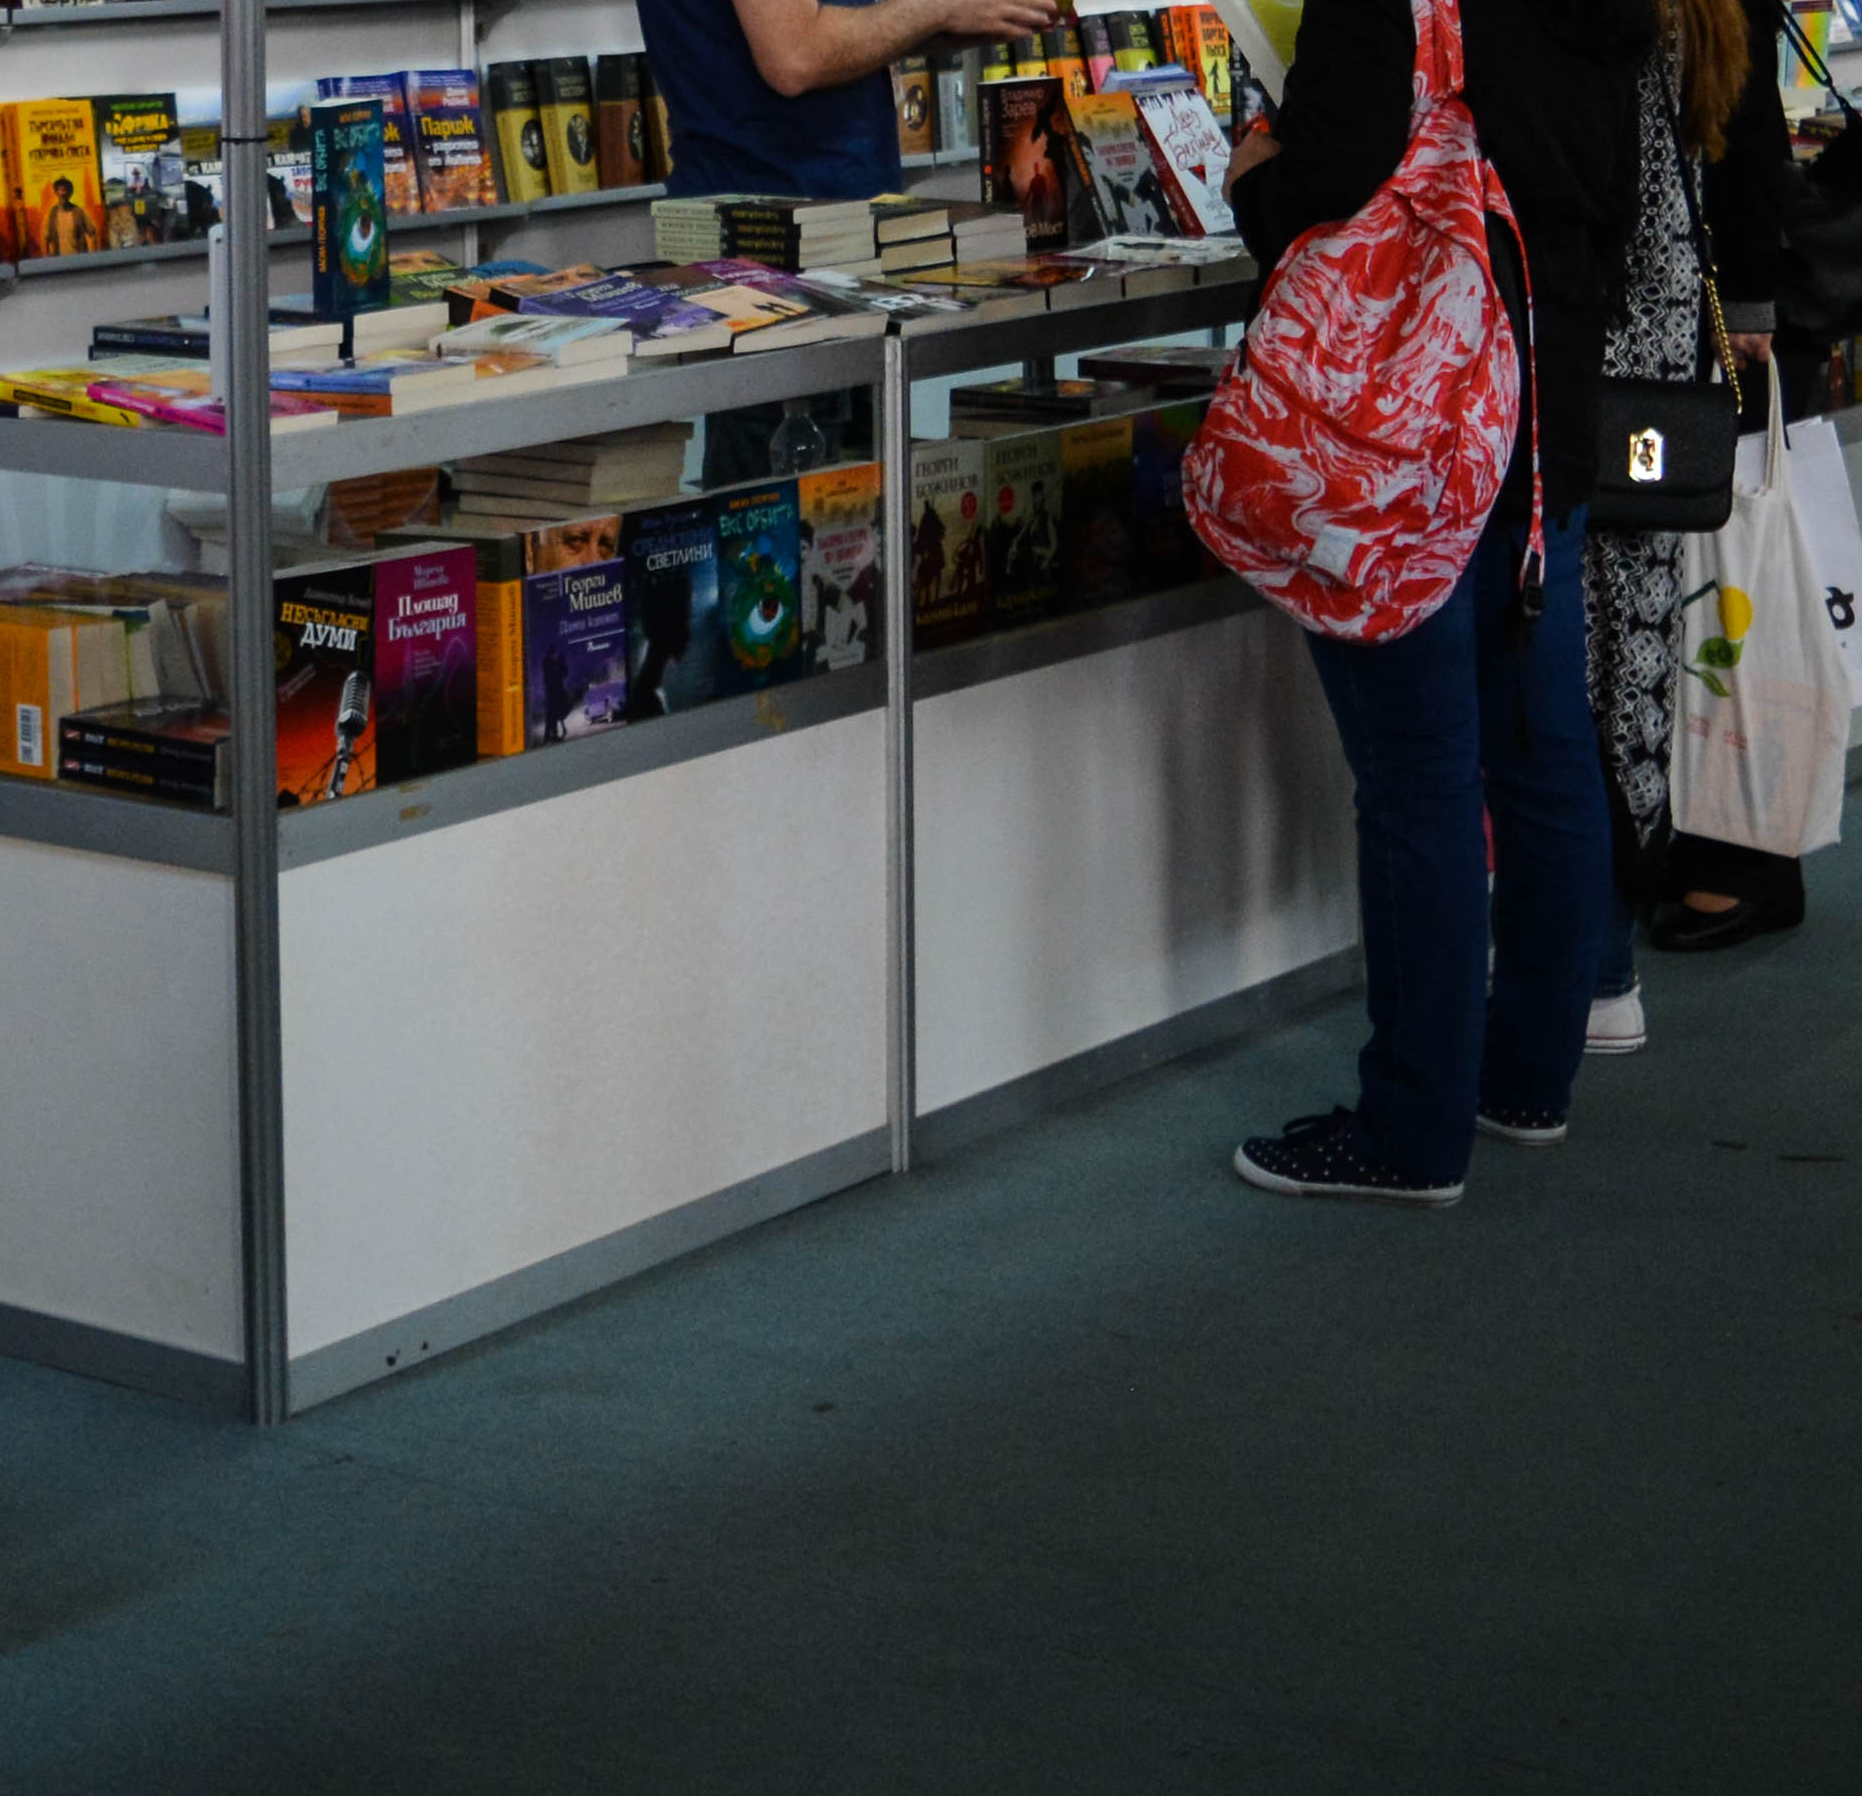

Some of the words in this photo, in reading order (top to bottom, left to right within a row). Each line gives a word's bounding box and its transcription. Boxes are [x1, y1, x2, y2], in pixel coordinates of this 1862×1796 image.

[915, 457, 959, 479] ГЕОРГИ
[915, 474, 979, 500] БОЖИНОВ
[720, 515, 742, 538] ЕКС
[745, 504, 794, 531] ОРБИТА
[646, 543, 714, 571] СВЕТЛИНИ
[563, 573, 606, 595] Георги
[397, 591, 458, 619] Площад
[569, 587, 623, 614] Мишев
[280, 601, 369, 631] НЕСЪГЛАСНИ
[387, 610, 466, 642] България
[299, 621, 356, 652] ДУМИ
